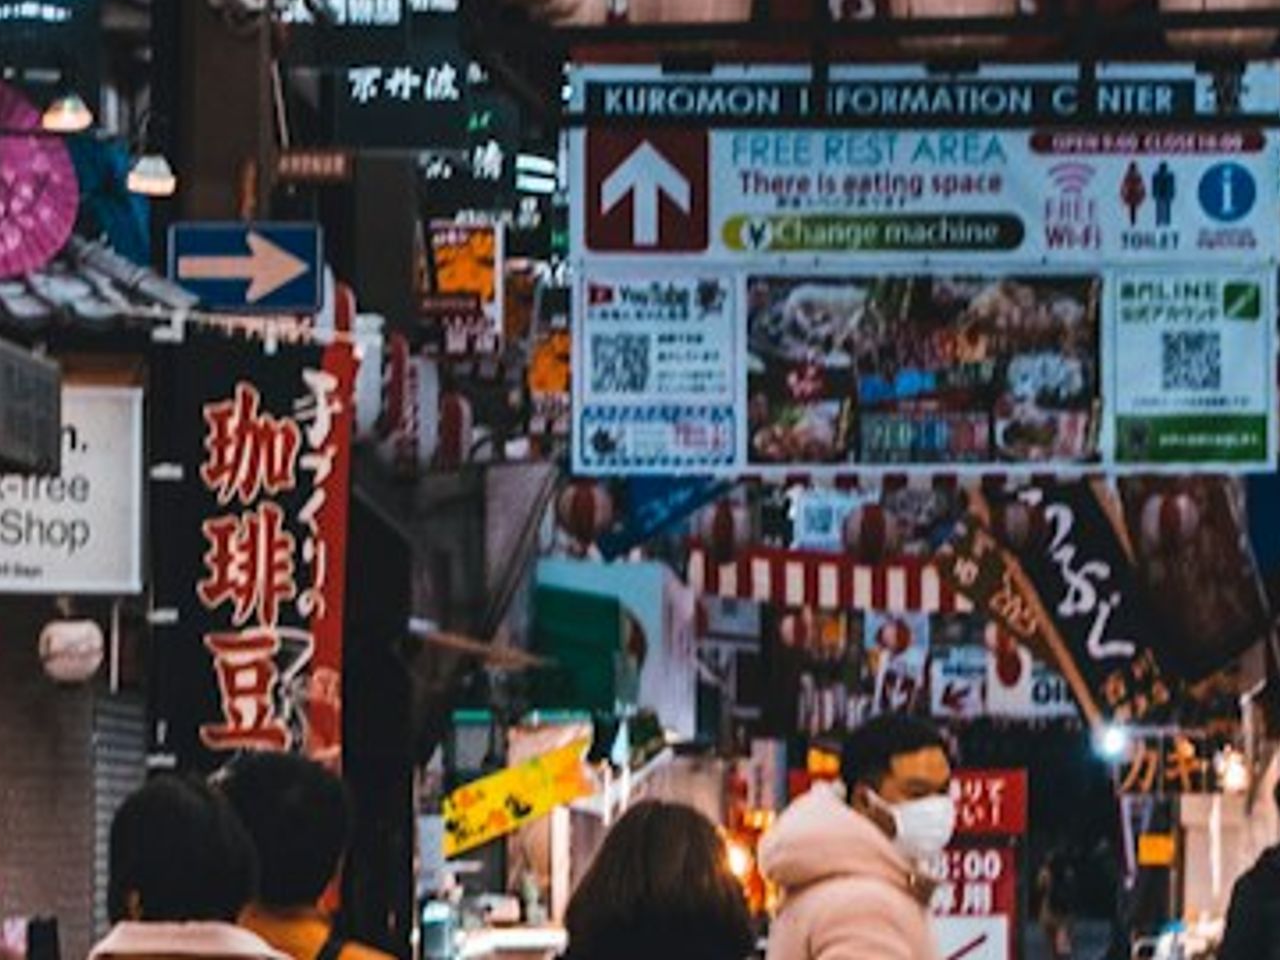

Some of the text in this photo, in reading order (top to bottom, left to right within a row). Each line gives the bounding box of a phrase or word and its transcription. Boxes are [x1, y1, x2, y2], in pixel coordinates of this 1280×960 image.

[604, 86, 780, 117] KUROMON
[1051, 83, 1175, 115] CNTER
[731, 135, 1008, 167] FREE REST AREA
[739, 170, 1003, 200] There is eating space
[774, 217, 877, 251] Change
[883, 216, 1001, 247] machine
[1120, 229, 1180, 251] TOILET
[196, 382, 299, 753] 珈琲豆
